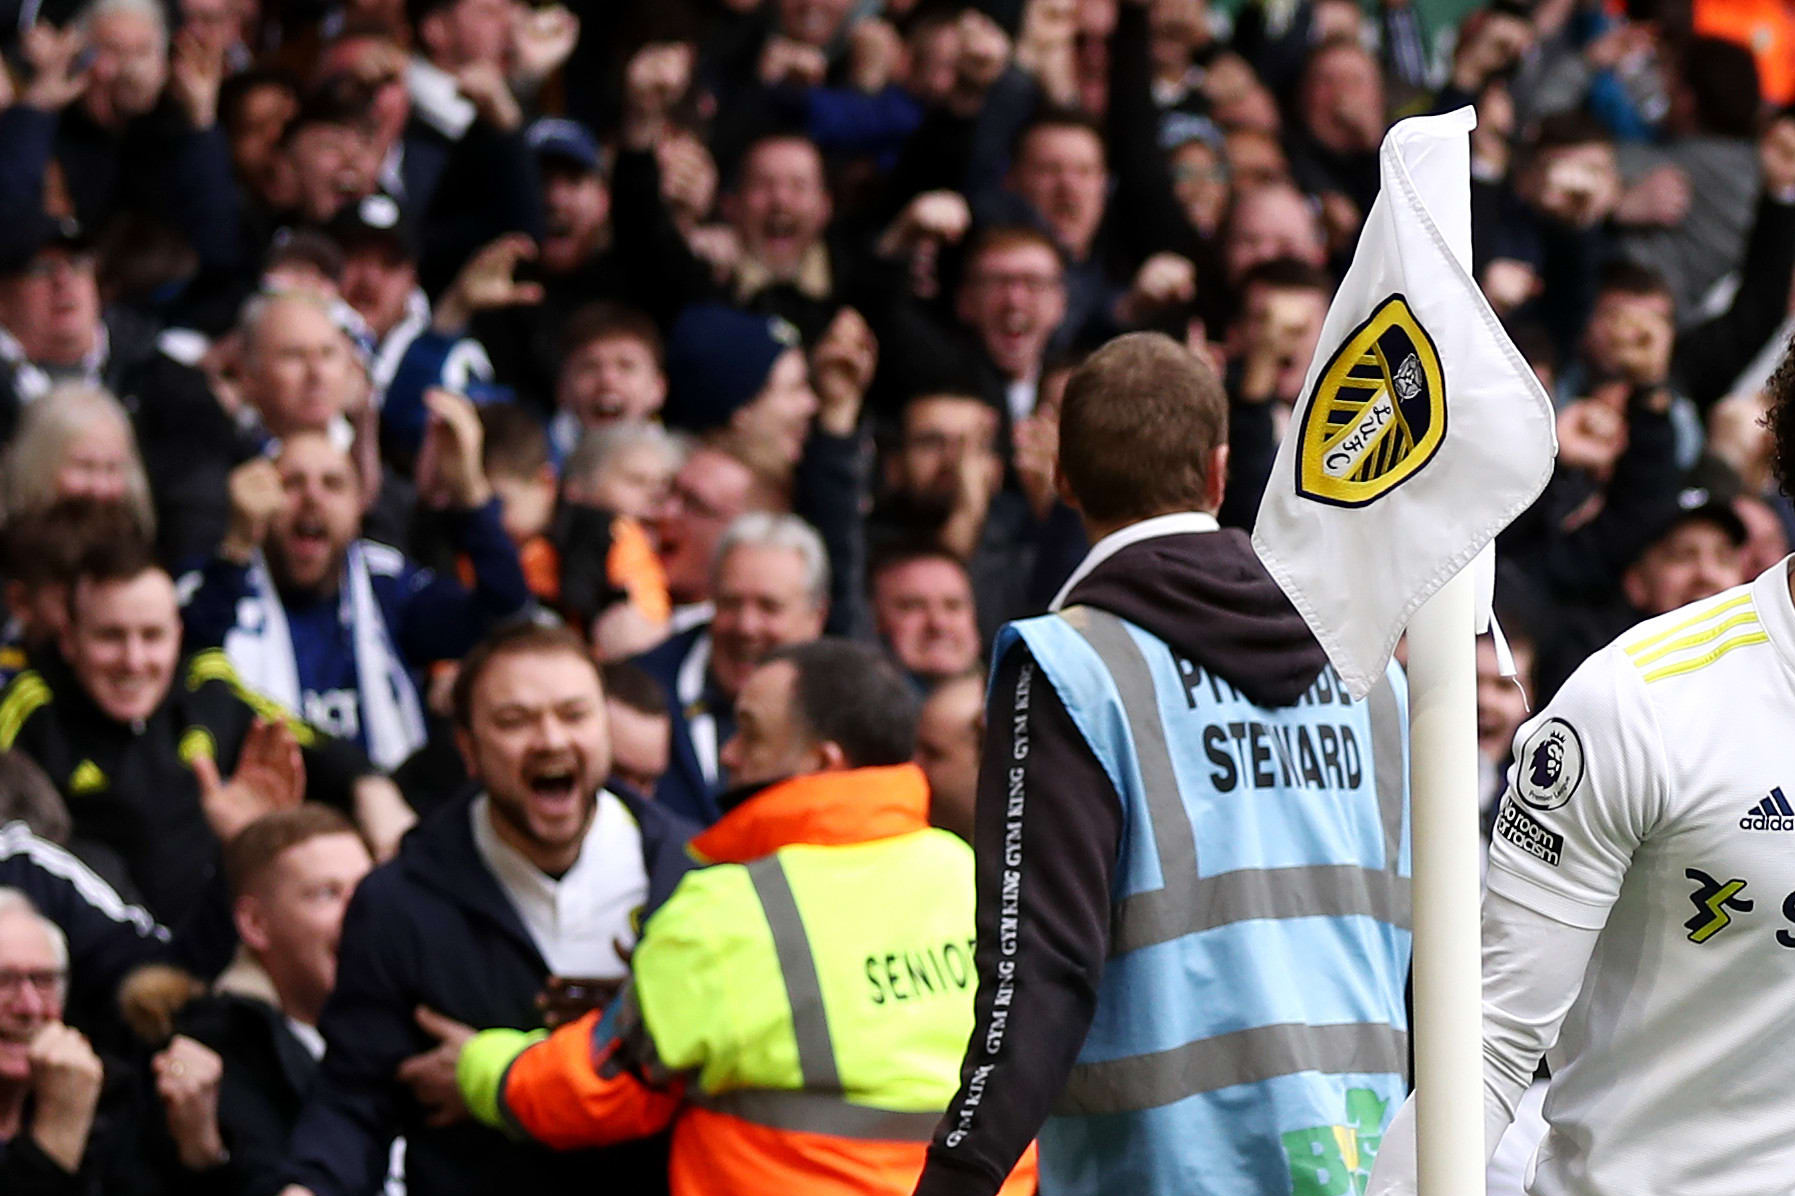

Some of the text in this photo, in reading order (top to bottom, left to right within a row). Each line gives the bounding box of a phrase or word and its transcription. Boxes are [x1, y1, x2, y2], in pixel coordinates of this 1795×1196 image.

[1014, 662, 1034, 711] KING
[1013, 714, 1029, 761] GYM
[1007, 766, 1025, 818] KING
[1005, 821, 1022, 867] GYM
[1507, 826, 1559, 866] racism
[1514, 813, 1554, 849] room
[1001, 869, 1021, 916] KING
[1000, 916, 1018, 956] GYM
[865, 938, 977, 1005] SENIO
[994, 960, 1015, 1006] KING
[986, 1010, 1008, 1054] GYM
